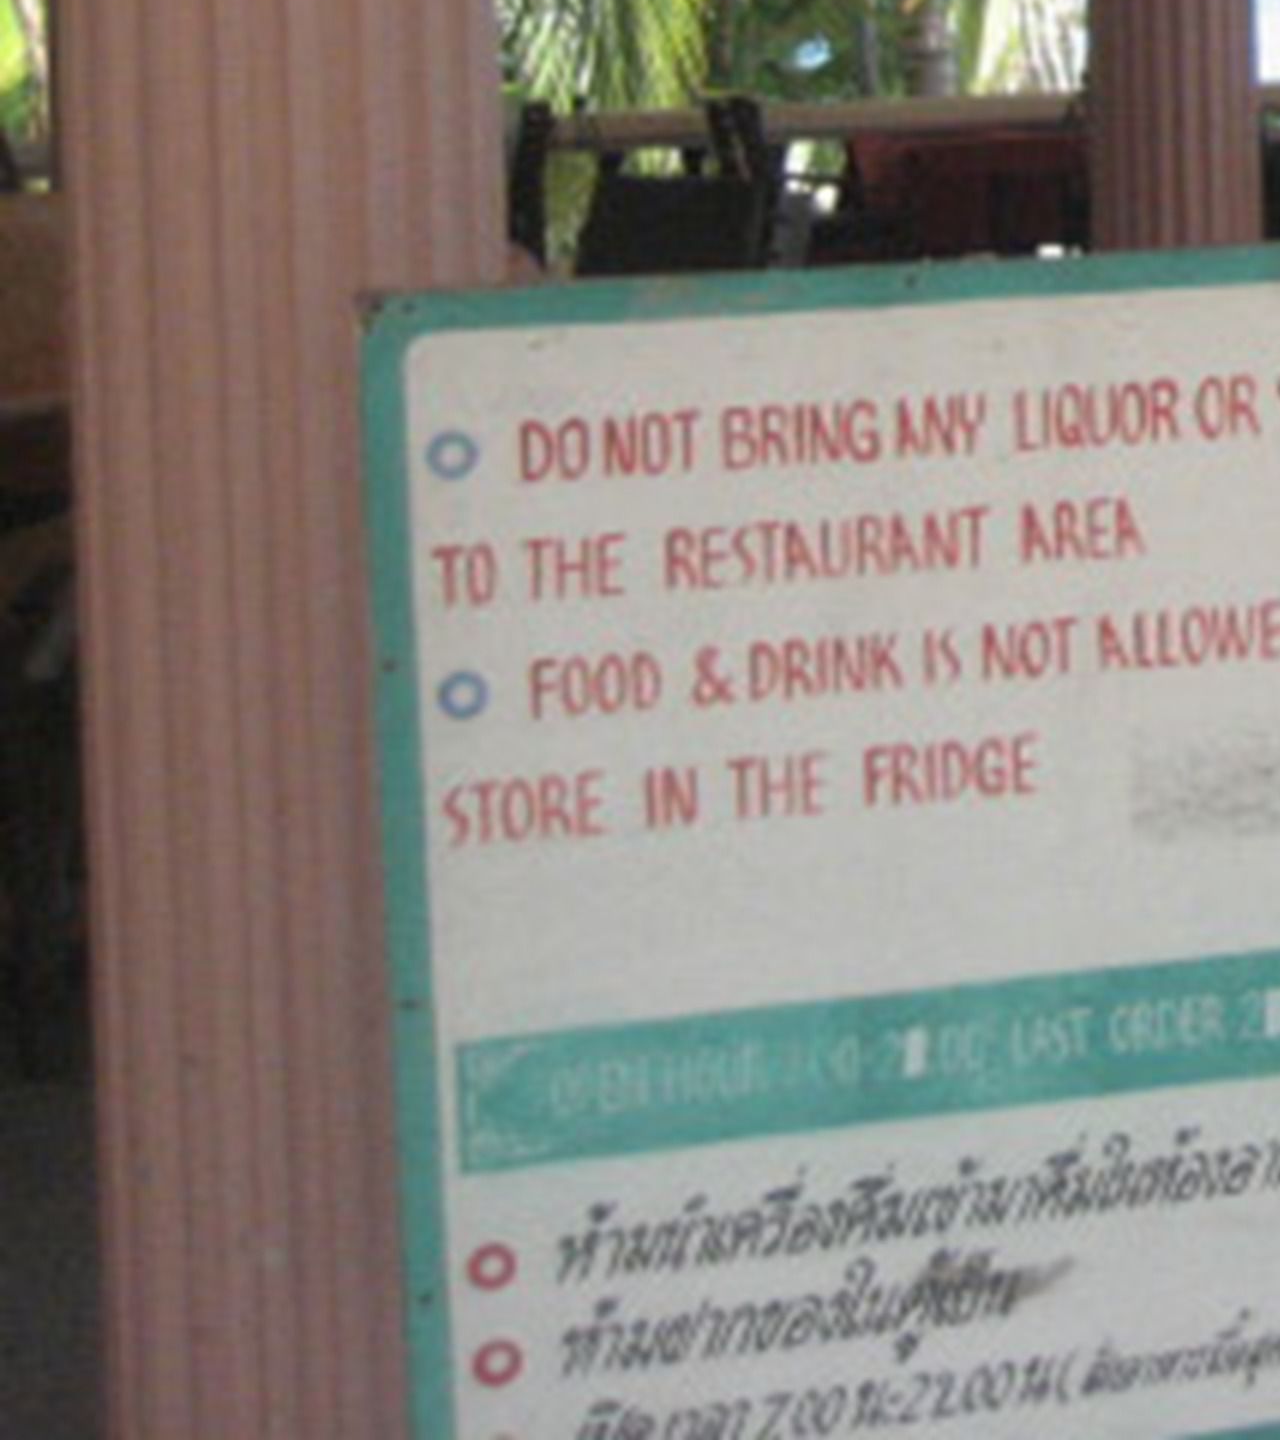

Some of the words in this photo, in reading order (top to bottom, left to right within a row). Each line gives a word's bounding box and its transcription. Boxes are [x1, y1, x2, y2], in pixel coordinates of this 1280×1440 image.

[519, 420, 590, 479] DO
[604, 411, 699, 474] NOT
[723, 403, 879, 466] BRING
[897, 397, 984, 453] ANY
[1014, 380, 1179, 449] LIQUOR
[1196, 376, 1259, 437] OR
[432, 546, 494, 605] TO
[525, 536, 624, 598] THE
[664, 507, 988, 590] RESTAURANT
[1021, 498, 1146, 560] AREA
[531, 655, 660, 718] FOOD
[692, 648, 733, 706] &
[749, 635, 901, 698] DRINK
[924, 631, 959, 686] IS
[982, 618, 1076, 679] NOT
[444, 771, 603, 844] STORE
[645, 770, 696, 827] IN
[727, 756, 825, 817] THE
[863, 733, 1038, 809] FRIDGE
